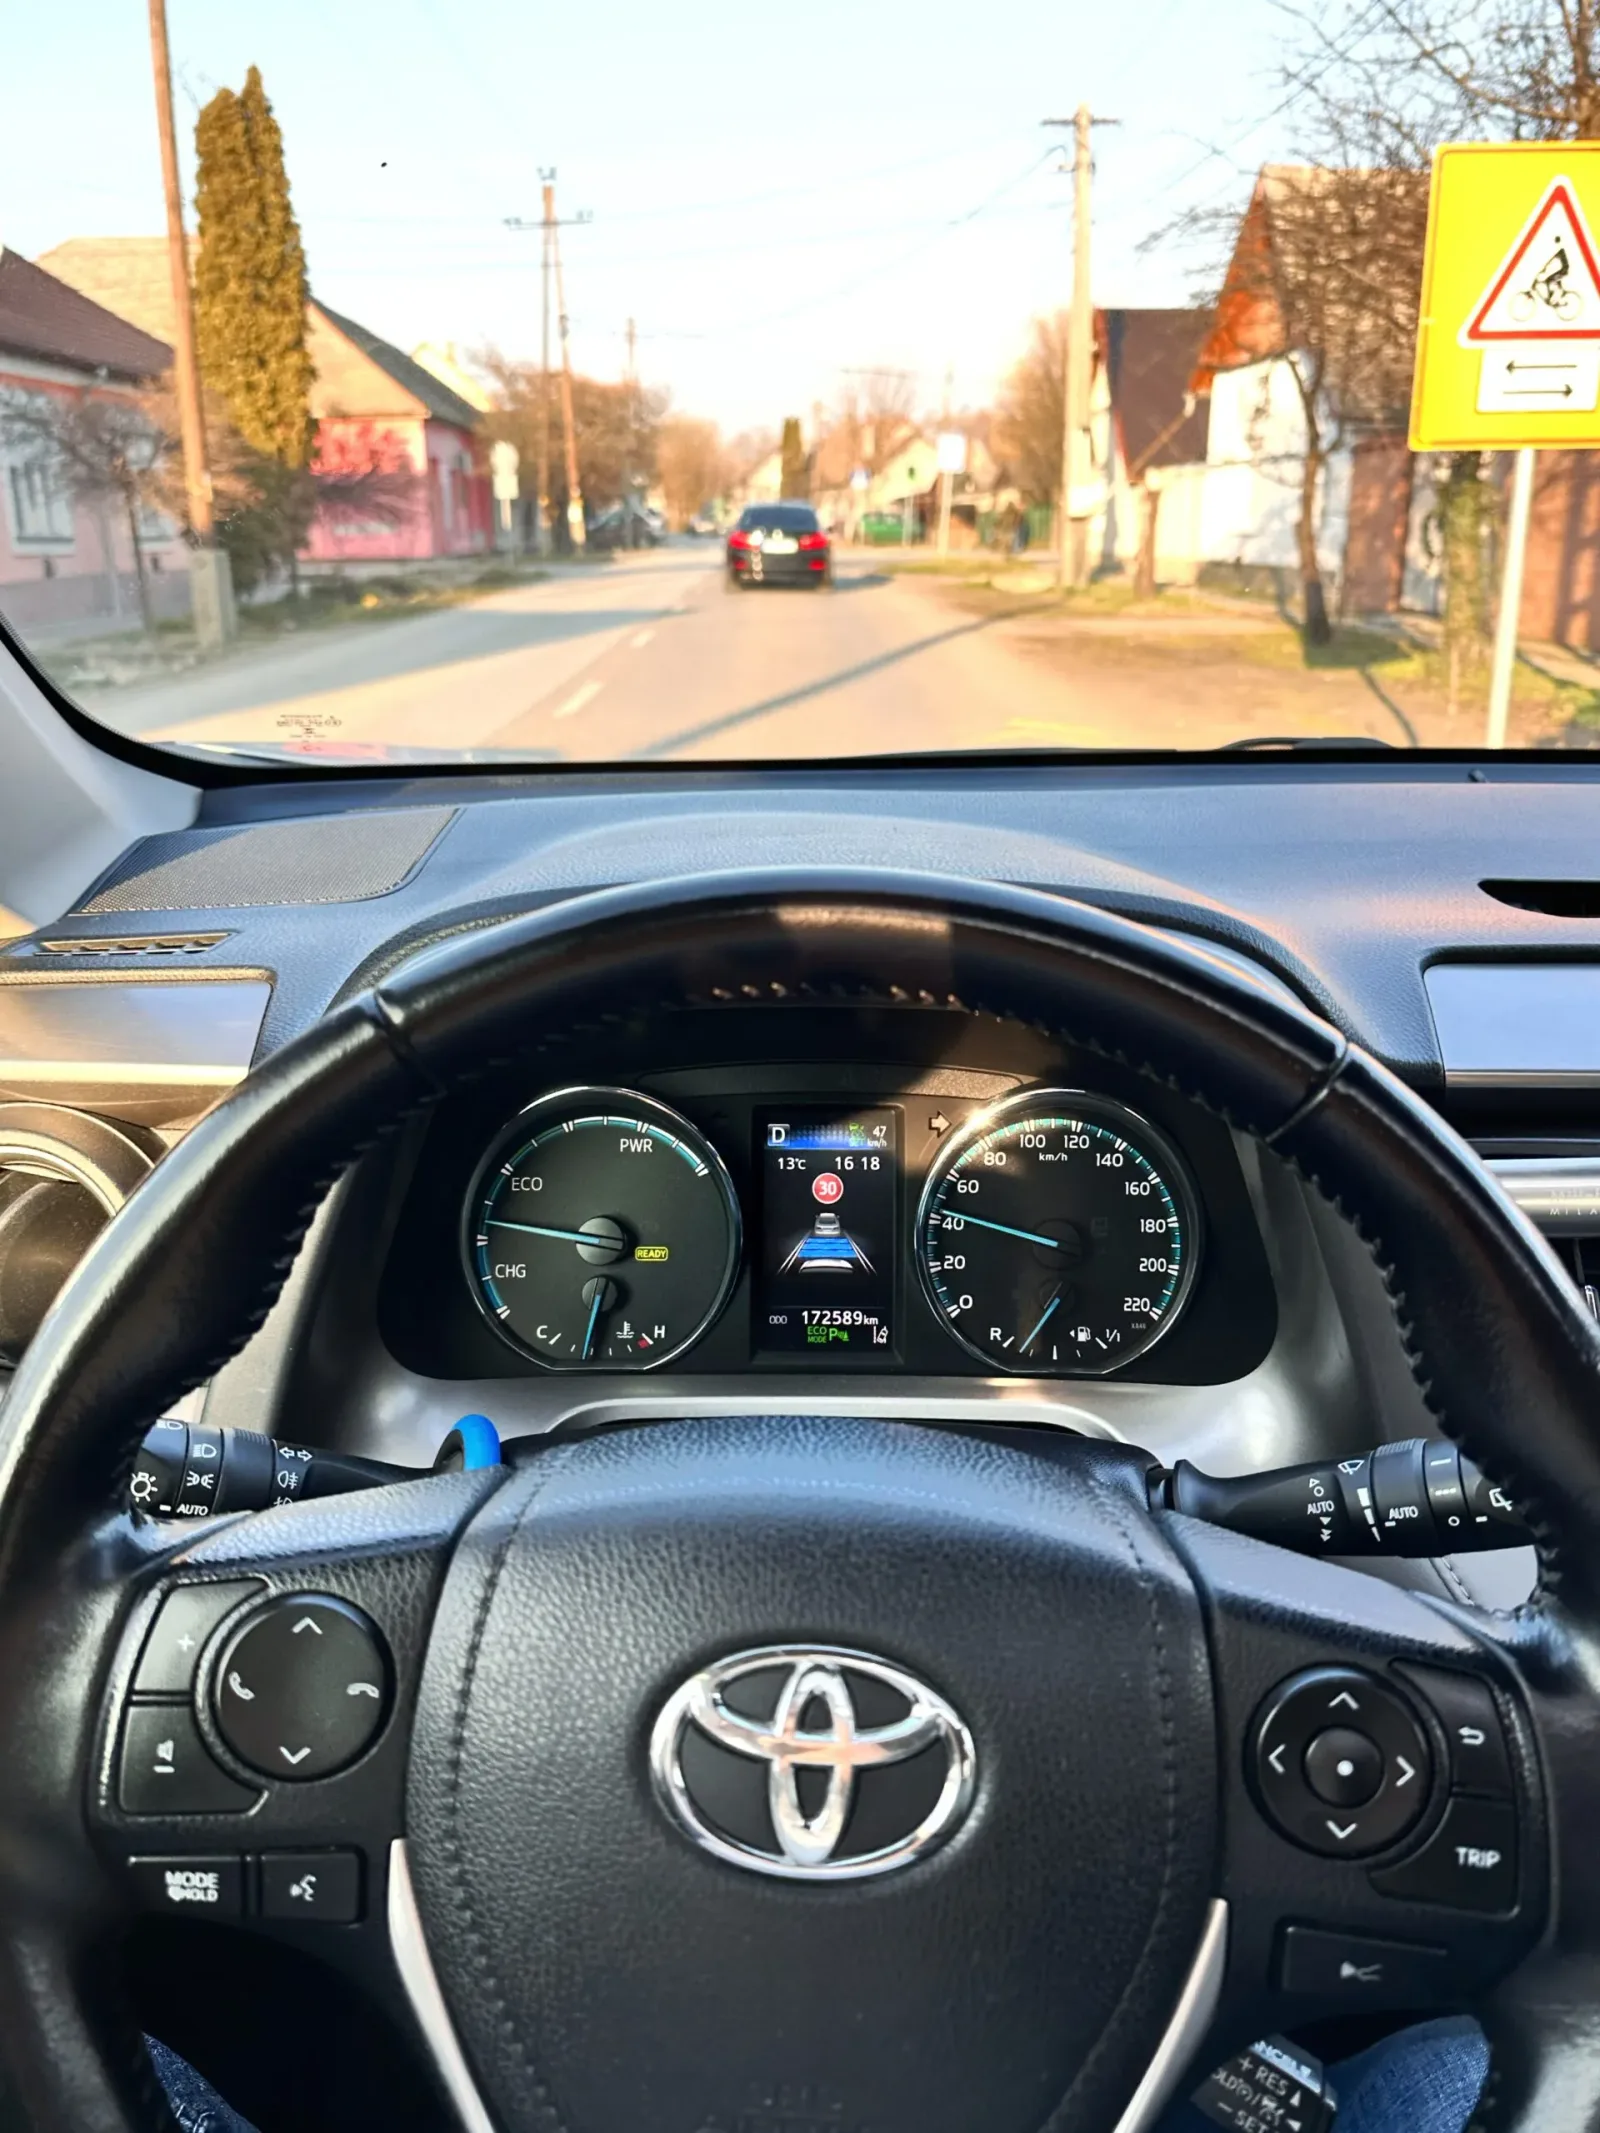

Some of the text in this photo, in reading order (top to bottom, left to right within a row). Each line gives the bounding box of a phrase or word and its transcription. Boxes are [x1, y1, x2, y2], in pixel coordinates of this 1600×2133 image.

[771, 1126, 786, 1143] D
[872, 1126, 887, 1138] 47
[619, 1138, 653, 1153] PWR
[867, 1138, 887, 1148] km/h
[1019, 1134, 1046, 1148] 100
[1064, 1135, 1090, 1149] 120
[983, 1152, 1006, 1166] 80
[1039, 1152, 1068, 1162] km/h
[1096, 1153, 1123, 1168] 140
[511, 1177, 543, 1192] ECO
[818, 1181, 837, 1196] 30
[957, 1179, 979, 1194] 60
[1124, 1181, 1150, 1196] 160
[942, 1217, 965, 1231] 40
[1140, 1218, 1166, 1233] 180
[636, 1249, 667, 1259] READY
[943, 1255, 966, 1270] 20
[1139, 1257, 1167, 1272] 200
[495, 1264, 526, 1279] CHG
[958, 1294, 973, 1309] 0
[1123, 1297, 1150, 1312] 220
[536, 1326, 548, 1339] C
[654, 1325, 666, 1338] H
[807, 1326, 827, 1335] ECO
[990, 1327, 1002, 1341] R
[176, 1503, 208, 1517] AUTO
[1307, 1500, 1335, 1516] AUTO
[1388, 1505, 1419, 1521] AUTO
[1455, 1847, 1501, 1868] TRIP
[165, 1870, 219, 1889] MODE
